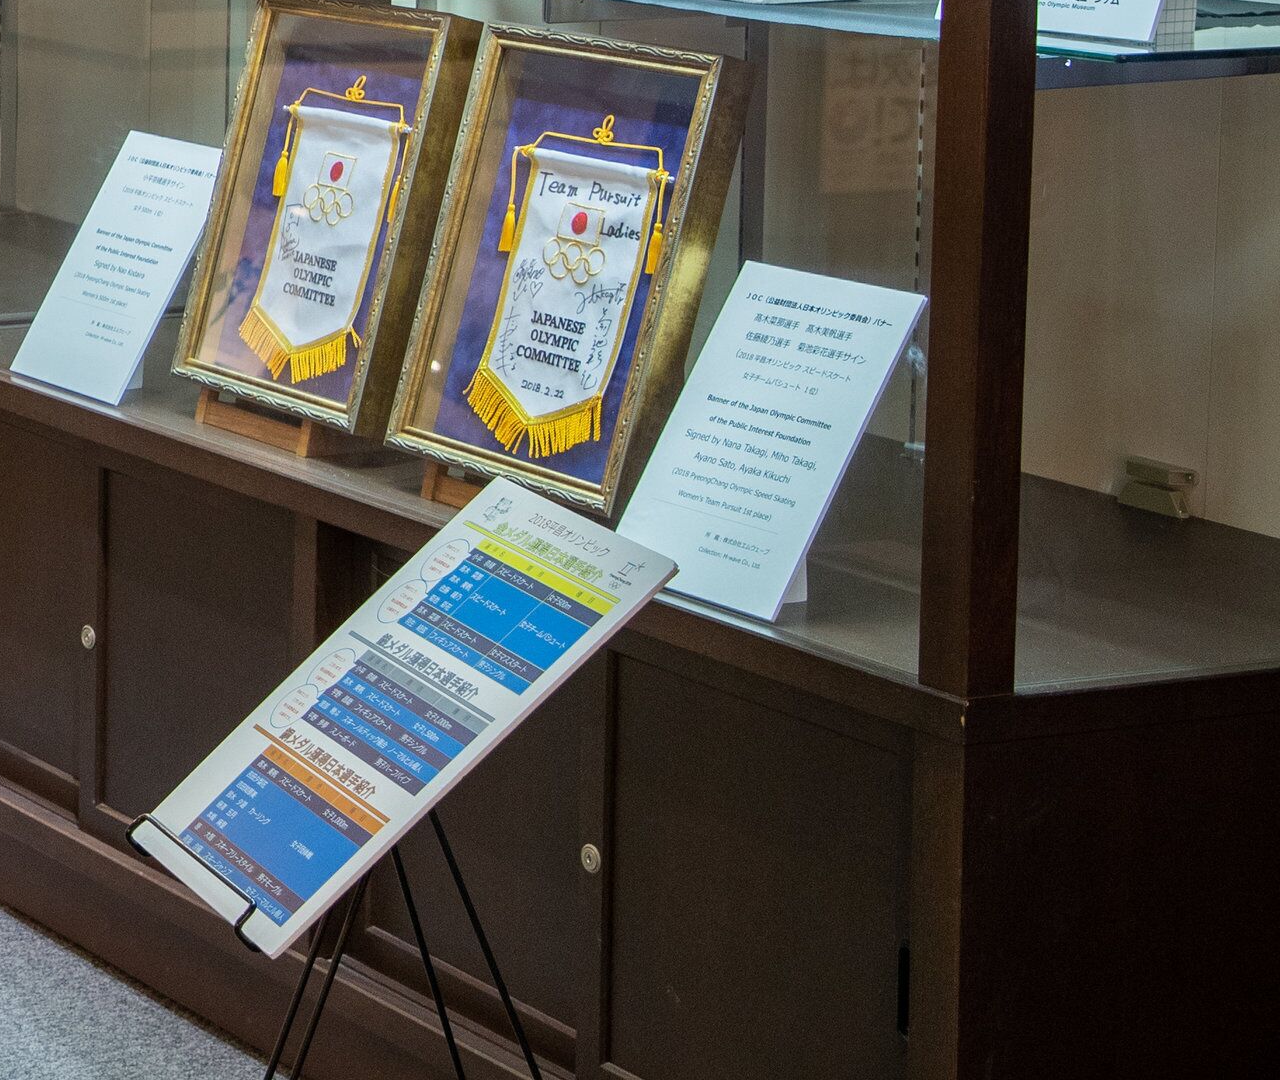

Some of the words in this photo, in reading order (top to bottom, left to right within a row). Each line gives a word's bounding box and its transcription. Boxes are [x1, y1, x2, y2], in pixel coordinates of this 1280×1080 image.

[539, 171, 579, 198] Team
[588, 180, 642, 208] Pursuit
[599, 217, 640, 241] Ladies
[292, 250, 338, 272] JAPANESE
[293, 267, 333, 288] OLYMPIC
[282, 282, 336, 307] COMMITTEE
[531, 310, 587, 335] JAPANESE
[530, 329, 579, 352] OLYMPIC
[516, 344, 582, 373] COMMITTEE
[706, 393, 729, 406] Banner
[730, 399, 737, 407] of
[738, 401, 749, 411] the
[749, 404, 768, 416] Japan
[769, 409, 796, 422] Olympic
[796, 415, 832, 431] Committee
[709, 415, 717, 423] of
[716, 416, 728, 425] the
[728, 419, 748, 431] Public
[748, 424, 775, 437] Interest
[774, 431, 811, 447] Foundation
[685, 428, 711, 443] Signed
[711, 434, 721, 446] by
[722, 438, 741, 451] Nana
[743, 443, 769, 458] Takagi,
[771, 450, 790, 463] Miho
[791, 455, 817, 472] Takagi,
[694, 451, 718, 465] Ayano
[718, 457, 737, 471] Sato,
[739, 463, 762, 478] Ayaka
[763, 469, 792, 485] Kikuchi
[671, 467, 690, 479] (2018
[690, 472, 729, 491] PyeongChang
[729, 482, 753, 497] Olympic
[754, 489, 774, 501] Speed
[773, 493, 797, 508] Skating
[705, 496, 721, 508] Team
[721, 501, 743, 515] Pursuit
[743, 507, 753, 516] 1st
[752, 508, 772, 522] place)
[528, 512, 611, 558] 2018平昌オリンピック
